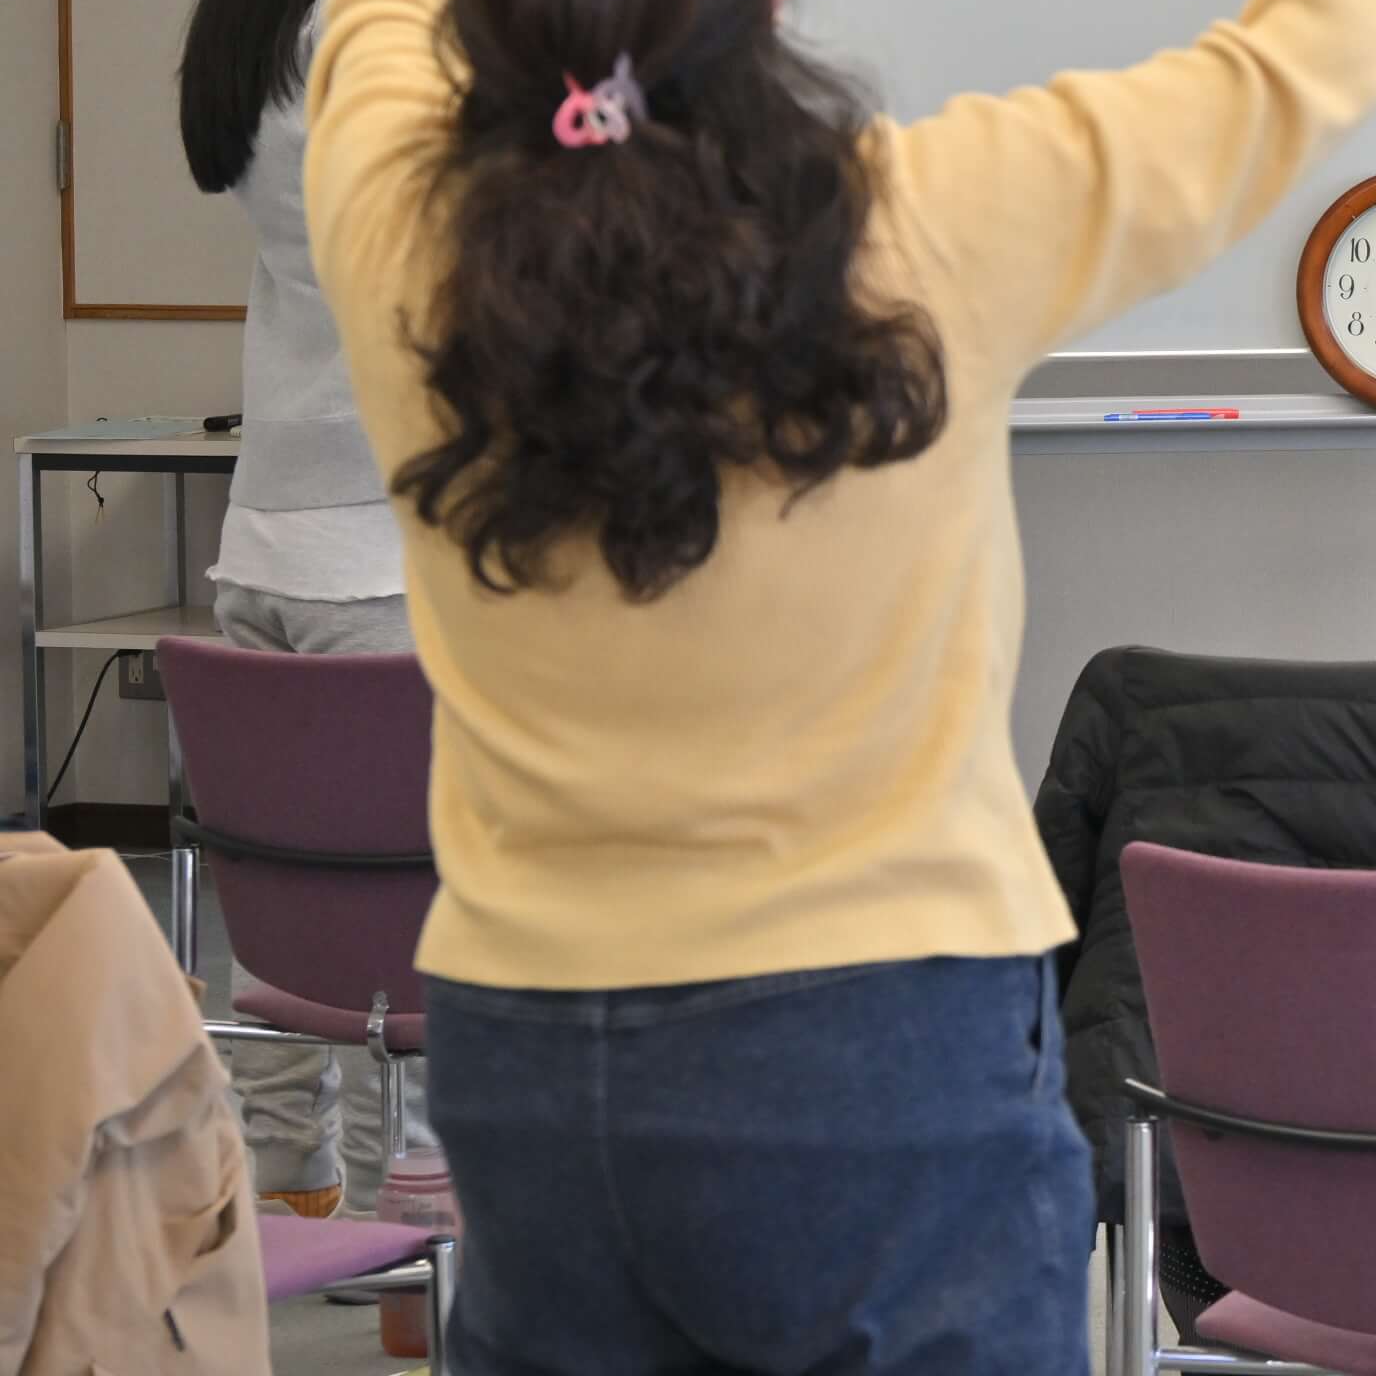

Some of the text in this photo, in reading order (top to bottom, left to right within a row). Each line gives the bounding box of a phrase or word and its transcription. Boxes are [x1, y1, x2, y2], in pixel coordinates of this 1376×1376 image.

[1350, 237, 1371, 263] 10
[1338, 274, 1355, 300] 9
[1347, 311, 1365, 336] 8
